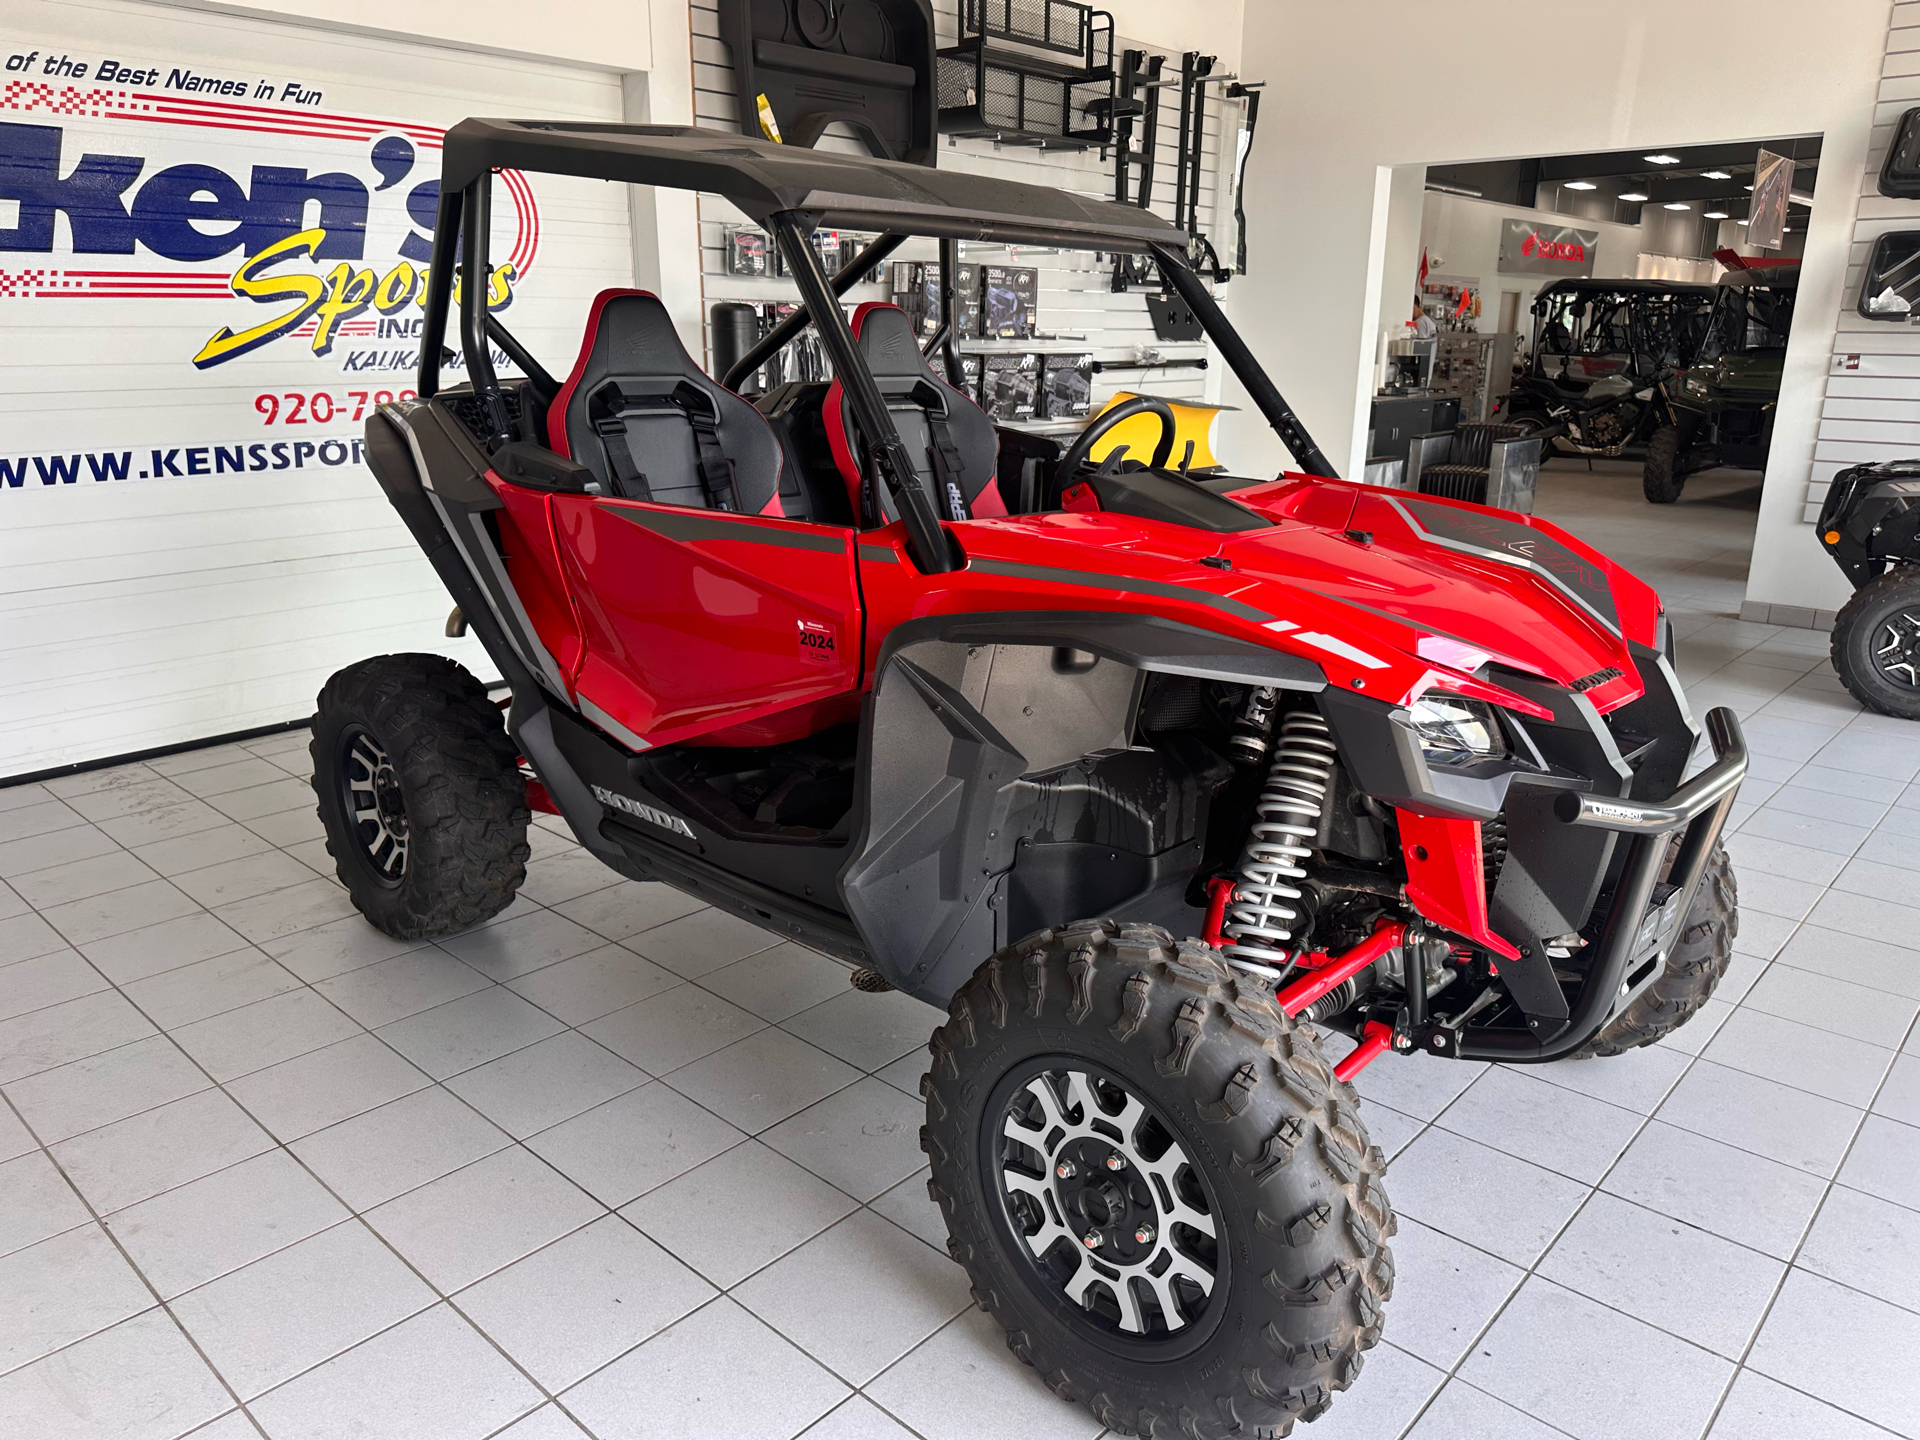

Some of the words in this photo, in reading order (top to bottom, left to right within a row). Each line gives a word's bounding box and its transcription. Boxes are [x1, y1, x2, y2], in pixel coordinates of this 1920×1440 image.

[5, 51, 39, 72] of
[43, 54, 88, 79] the
[95, 60, 159, 86] Best
[164, 68, 248, 97] Names
[253, 79, 275, 100] in
[280, 83, 323, 105] Fun
[1537, 240, 1584, 262] HONDA
[800, 631, 835, 651] 2024
[1569, 666, 1624, 692] HONDA
[590, 784, 697, 840] HONDA
